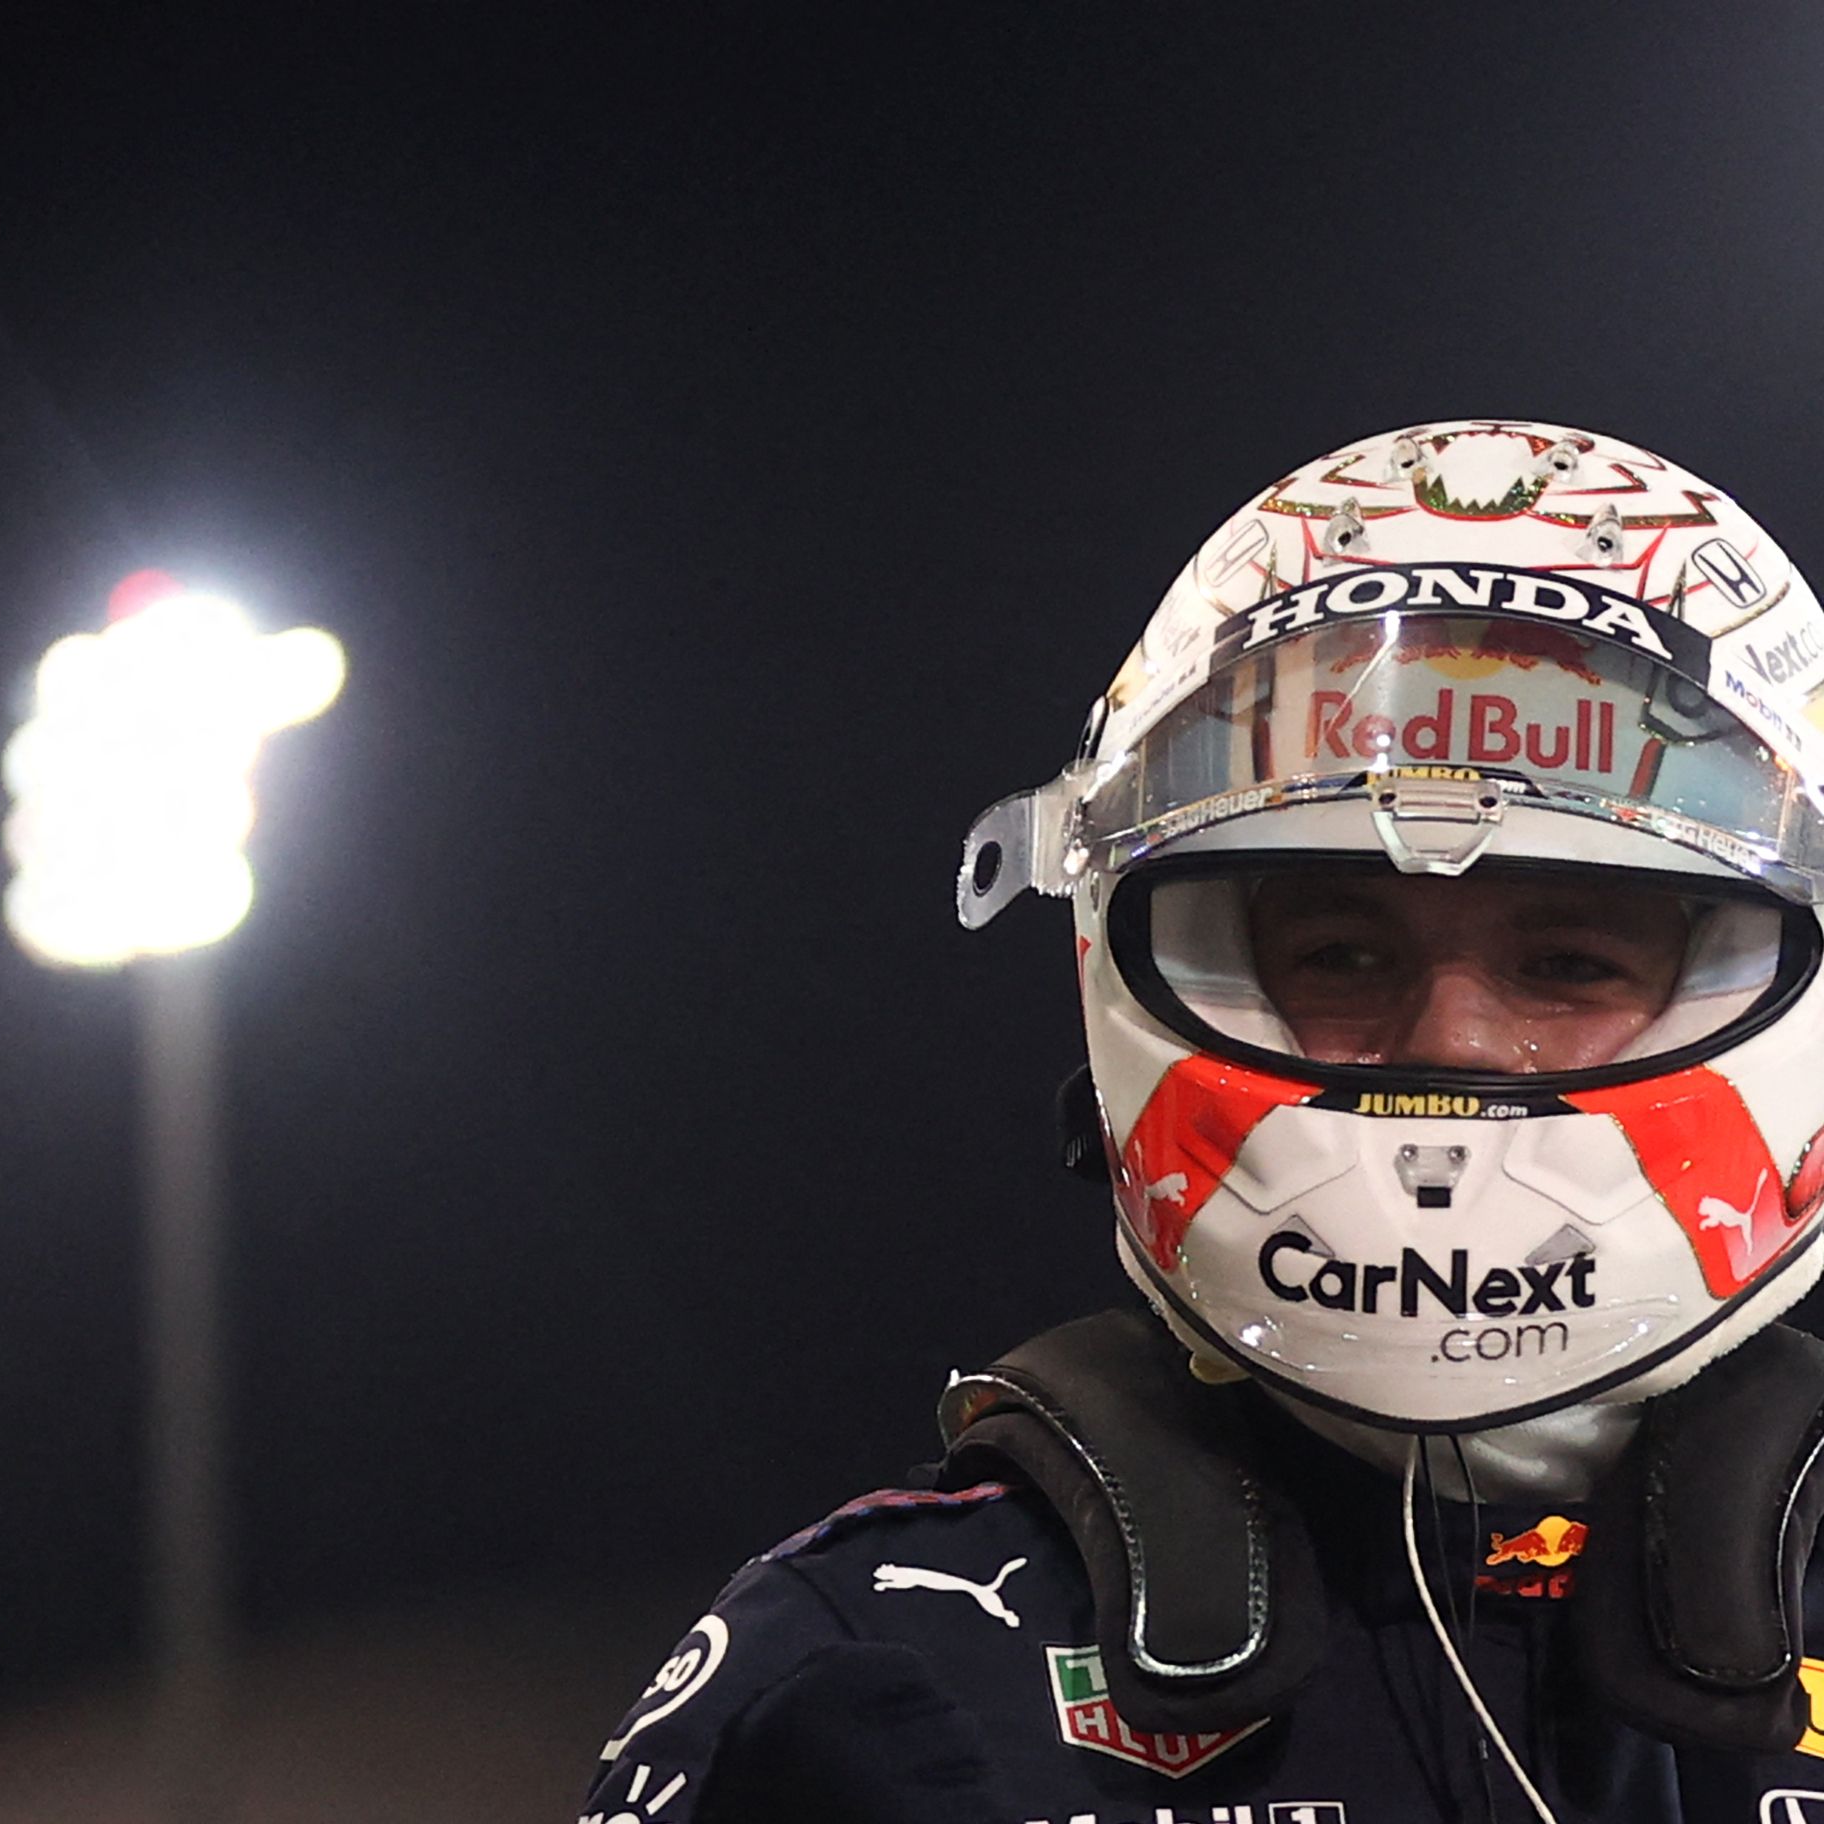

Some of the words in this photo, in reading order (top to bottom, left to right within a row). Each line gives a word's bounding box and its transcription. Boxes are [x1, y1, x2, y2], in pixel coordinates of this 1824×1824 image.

[1242, 568, 1673, 661] HONDA
[1305, 688, 1453, 760] Red
[1467, 693, 1614, 774] Bull
[1258, 1230, 1598, 1319] CarNext
[1430, 1320, 1569, 1364] .com
